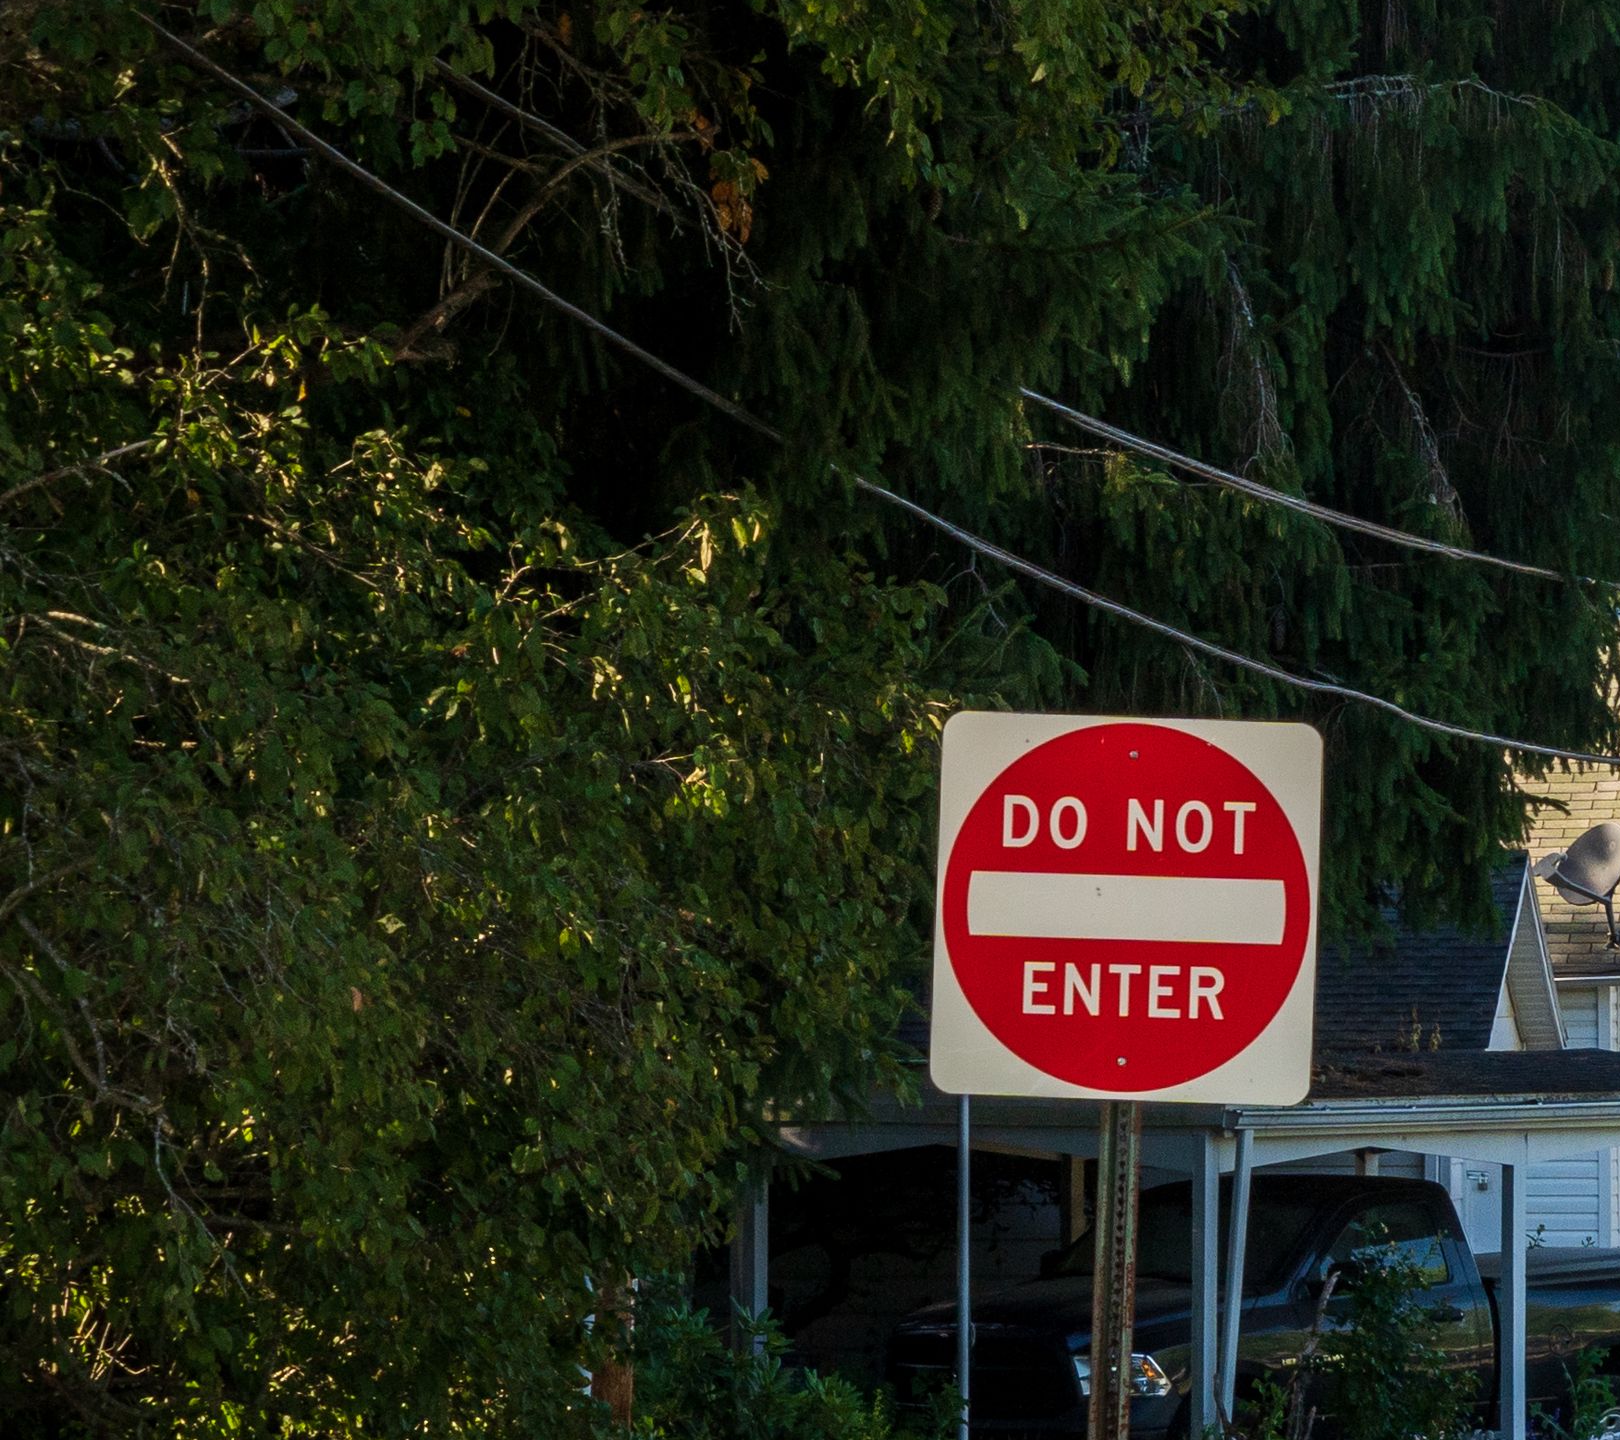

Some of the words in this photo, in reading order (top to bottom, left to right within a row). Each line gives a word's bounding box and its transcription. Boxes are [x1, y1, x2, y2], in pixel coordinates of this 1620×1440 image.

[1002, 794, 1088, 850] DO
[1126, 798, 1256, 855] NOT
[1022, 961, 1225, 1020] ENTER
